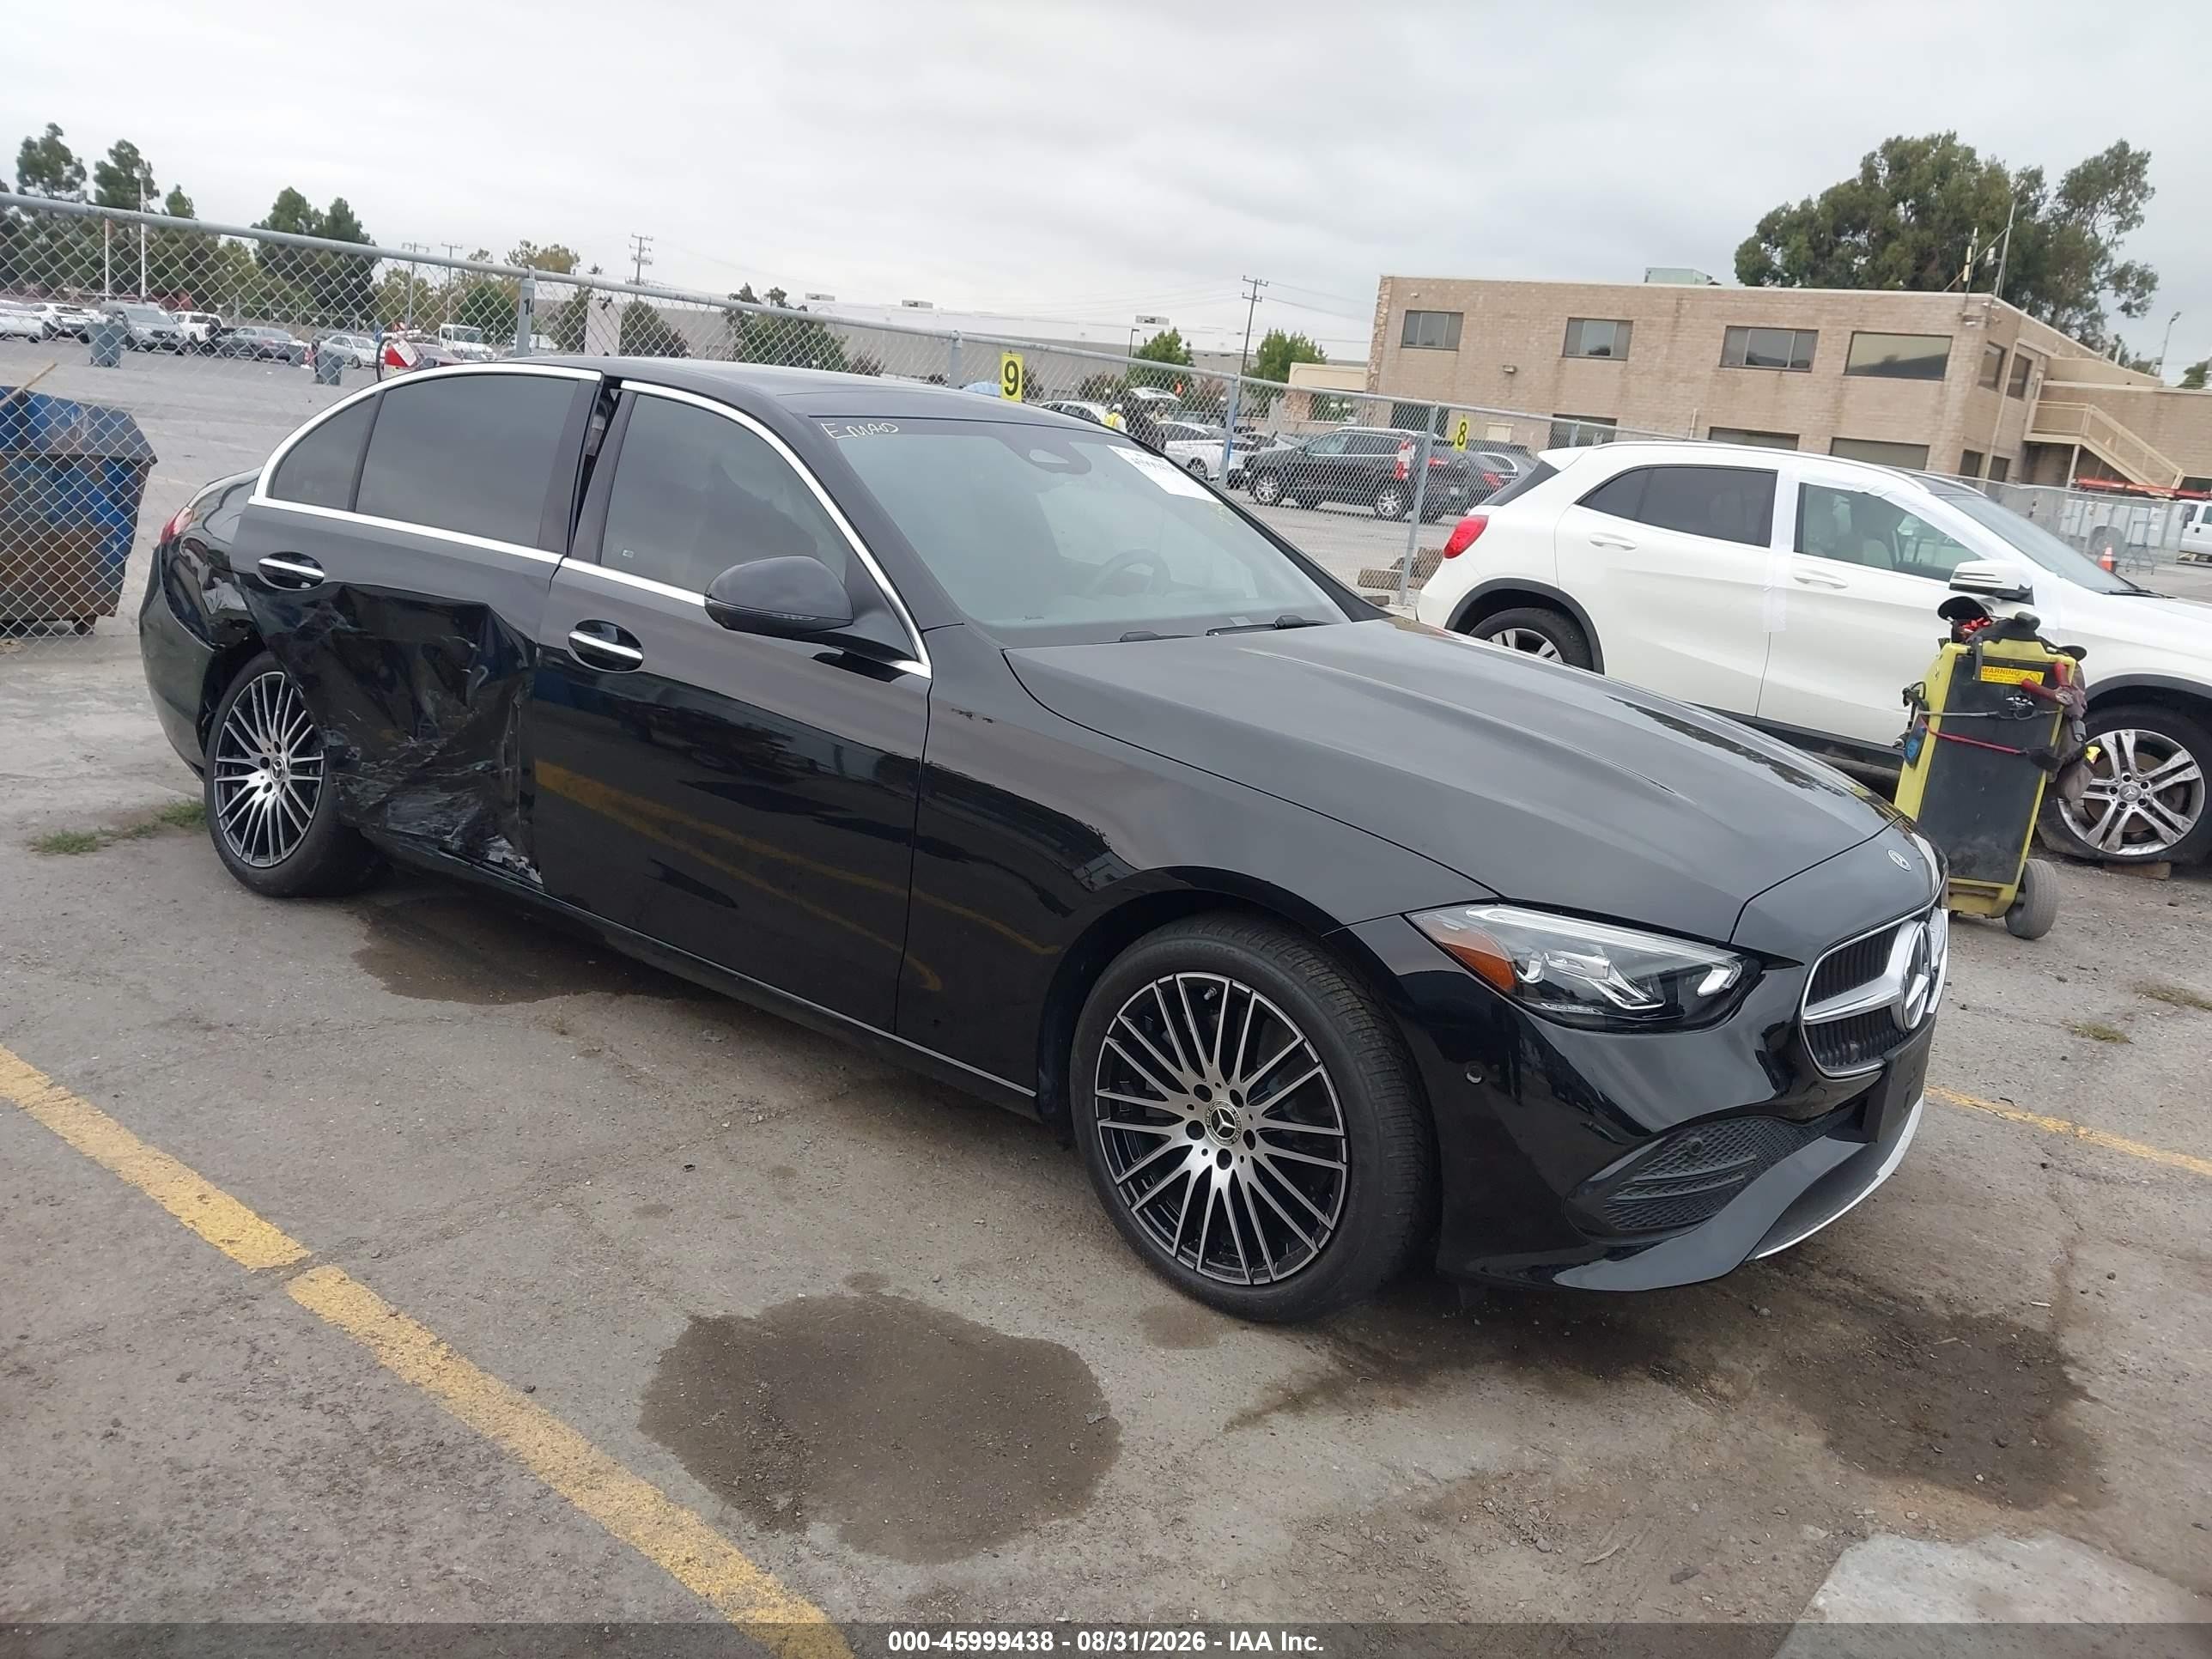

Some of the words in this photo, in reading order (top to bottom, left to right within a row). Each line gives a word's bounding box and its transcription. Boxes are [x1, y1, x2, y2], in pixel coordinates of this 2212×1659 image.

[1005, 360, 1019, 396] 9
[1457, 422, 1467, 446] 8
[1982, 666, 2020, 677] WARNING
